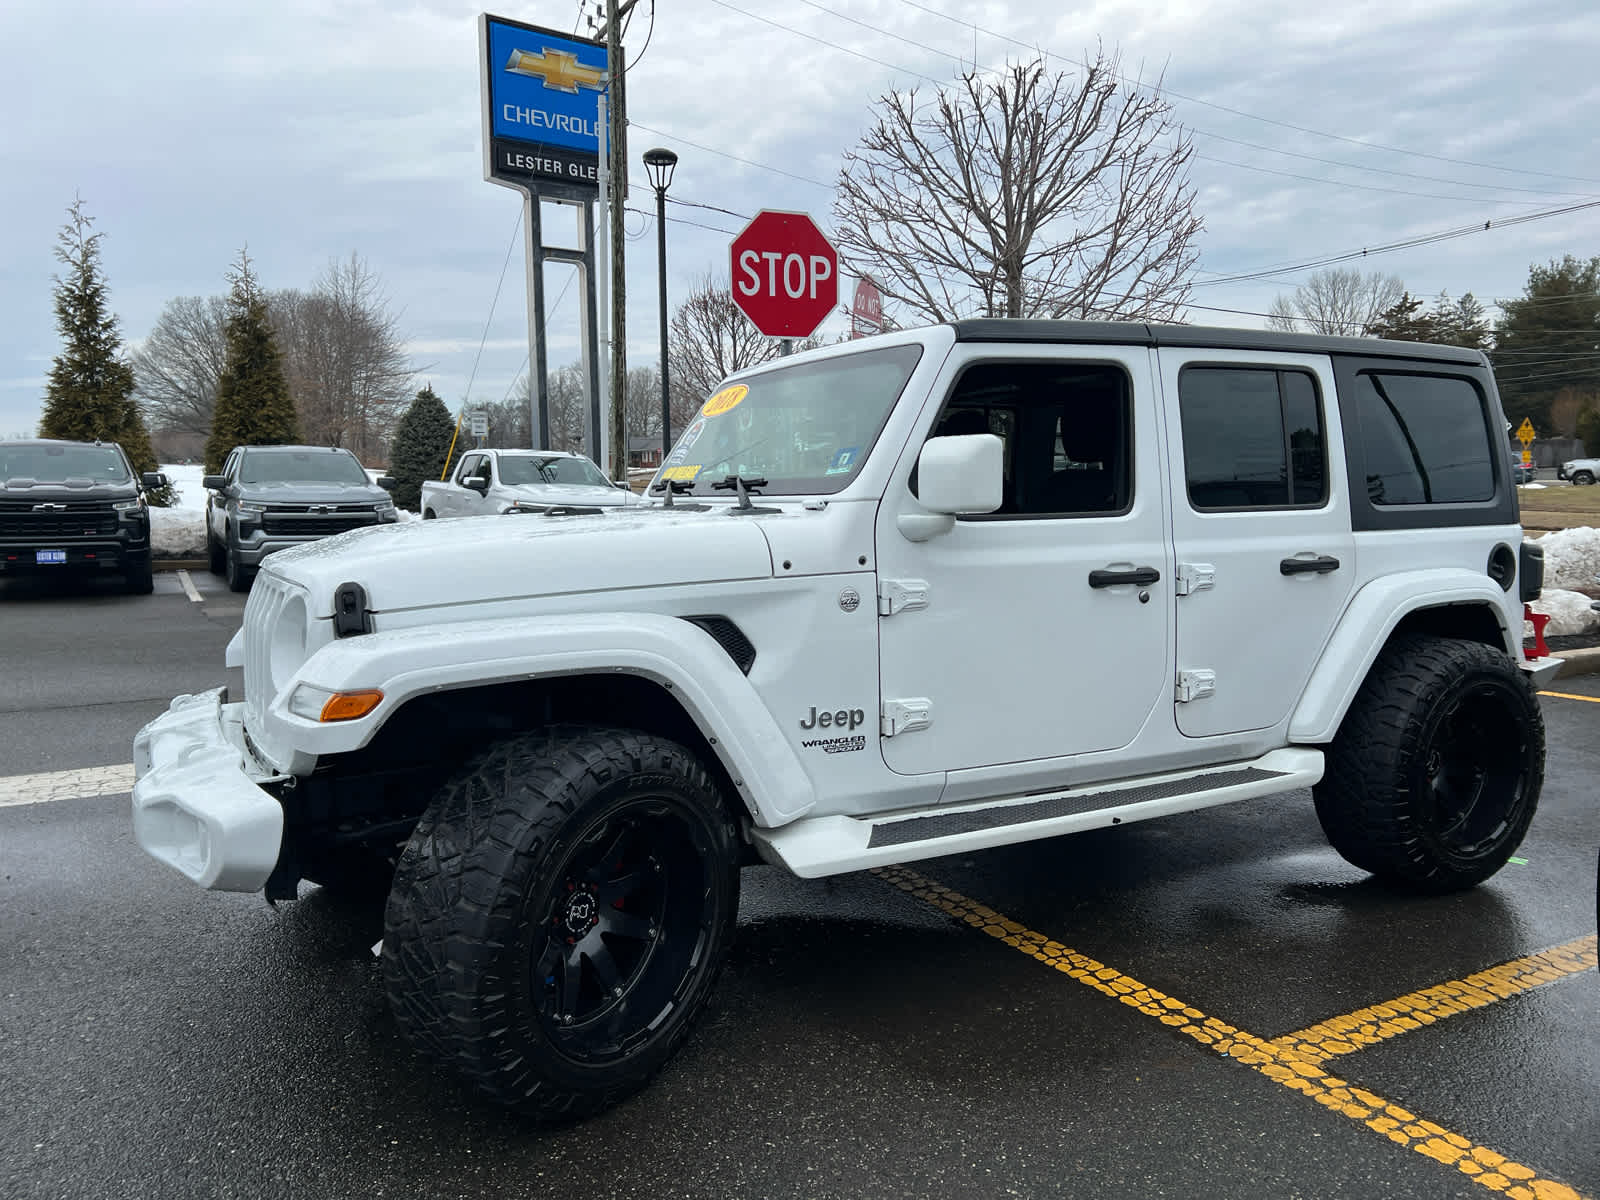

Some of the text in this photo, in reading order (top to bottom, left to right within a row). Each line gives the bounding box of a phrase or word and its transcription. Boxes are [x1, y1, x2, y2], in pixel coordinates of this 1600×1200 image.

[503, 103, 600, 137] CHEVROLE
[506, 152, 600, 180] LESTER GLE
[738, 249, 832, 299] STOP
[856, 292, 866, 311] DO
[800, 706, 865, 731] Jeep
[801, 735, 866, 748] WRANGLER
